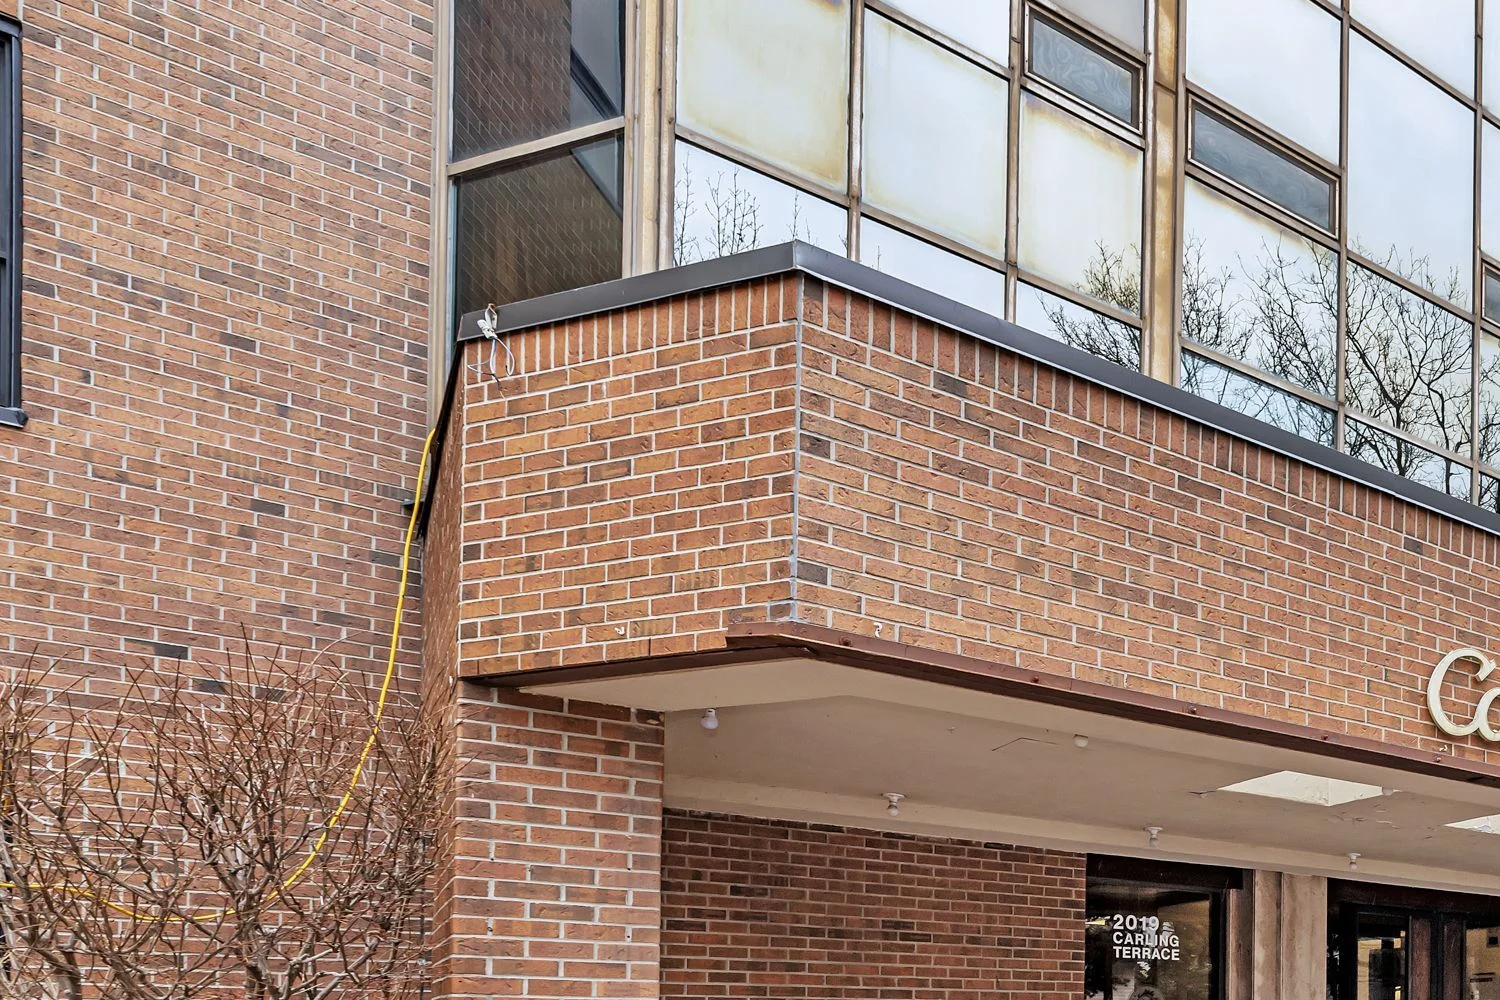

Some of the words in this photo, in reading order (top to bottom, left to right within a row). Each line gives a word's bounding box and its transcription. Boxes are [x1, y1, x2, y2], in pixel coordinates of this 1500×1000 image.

[1113, 914, 1160, 931] 2019
[1113, 932, 1180, 947] CARLING
[1113, 946, 1180, 961] TERRACE
